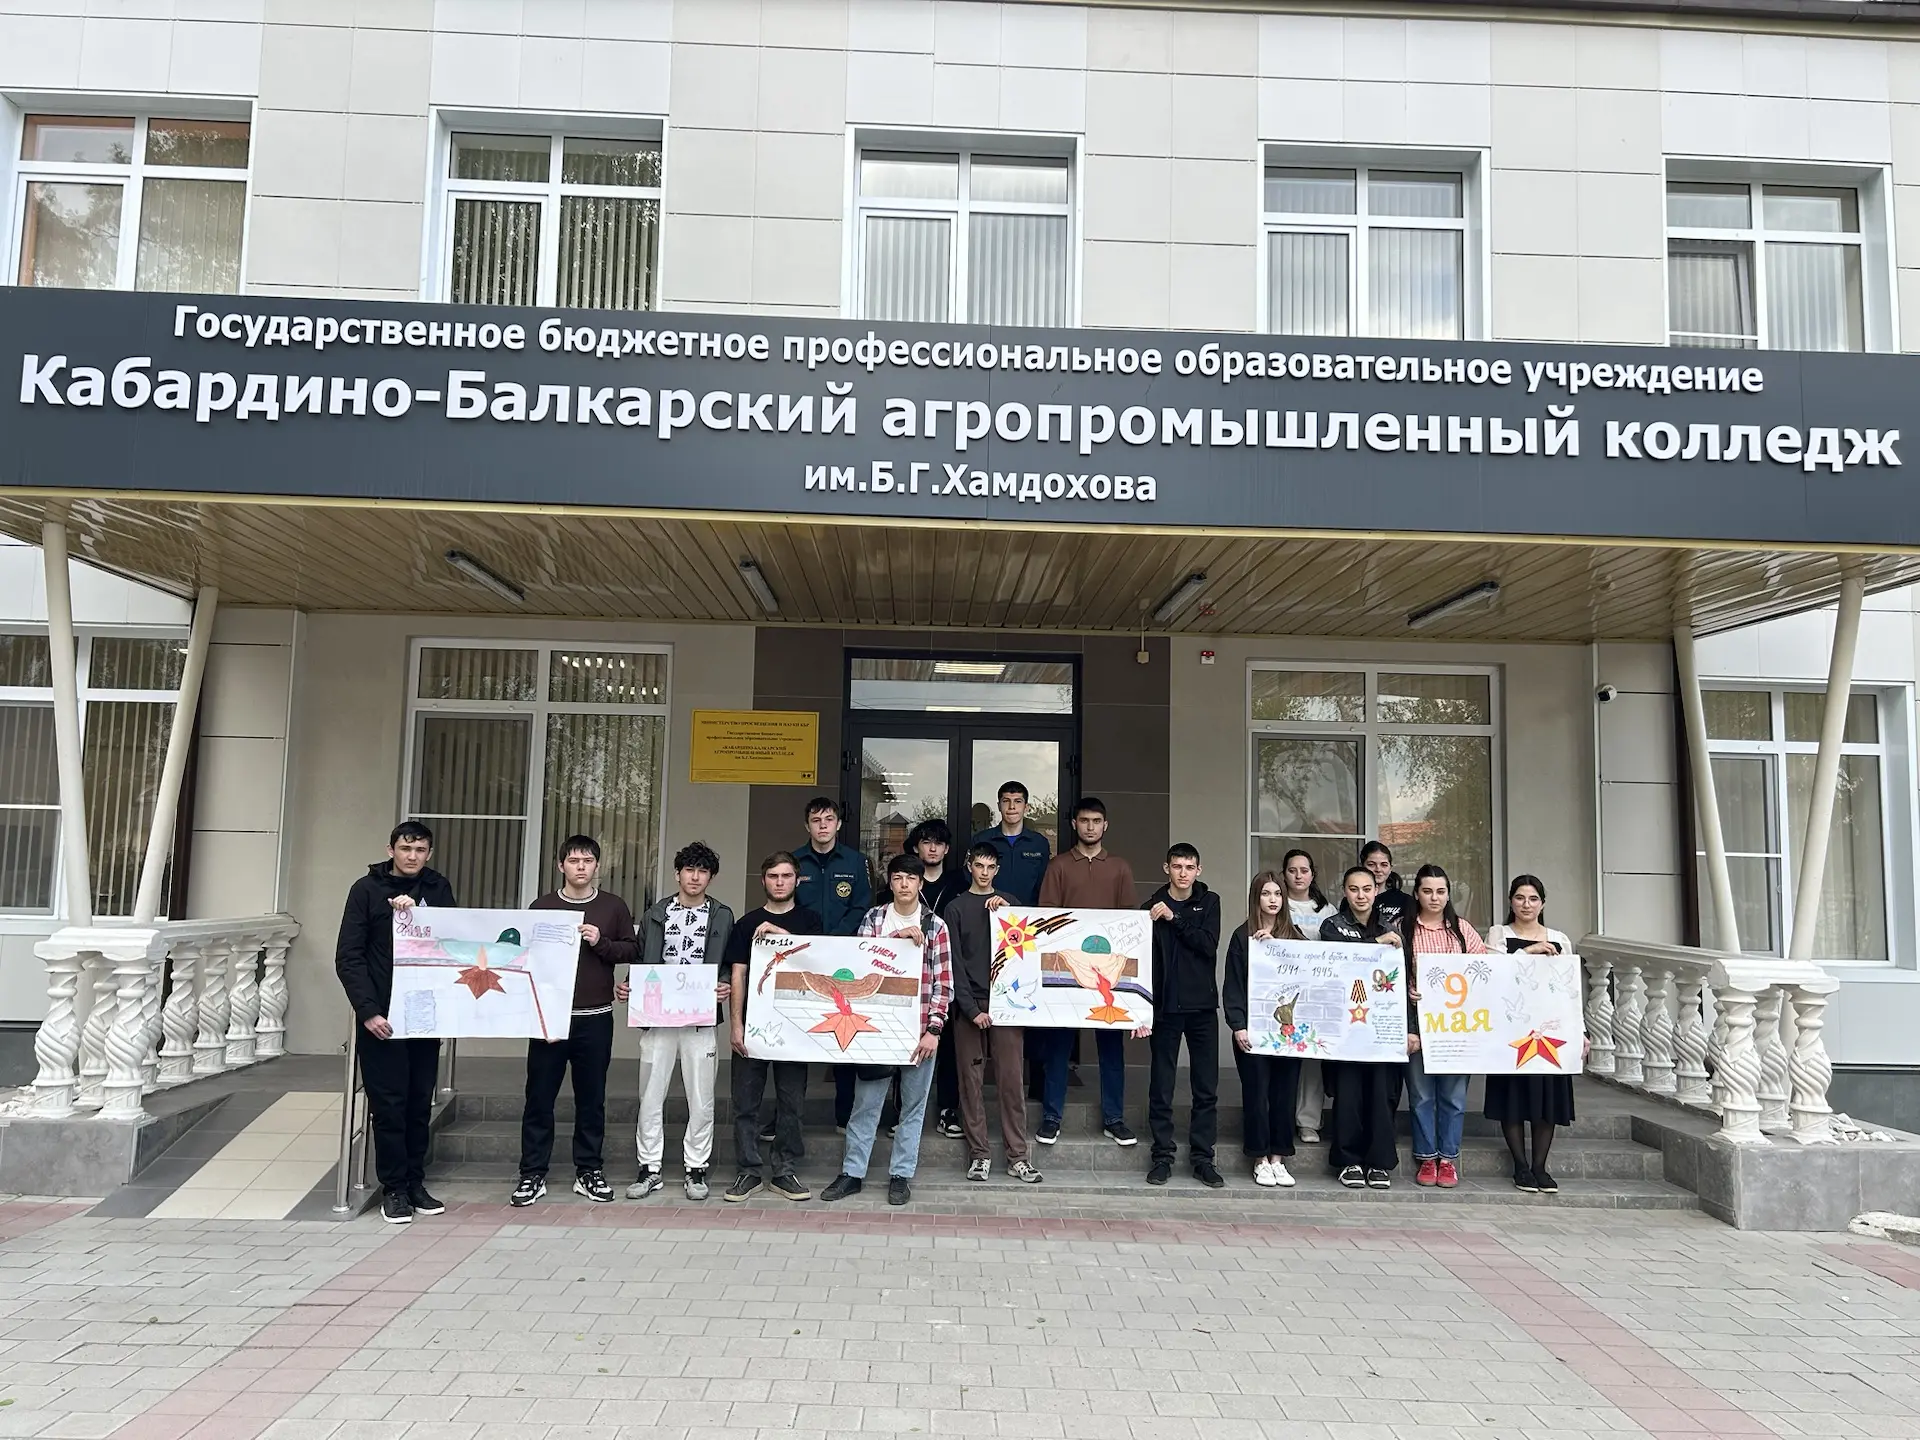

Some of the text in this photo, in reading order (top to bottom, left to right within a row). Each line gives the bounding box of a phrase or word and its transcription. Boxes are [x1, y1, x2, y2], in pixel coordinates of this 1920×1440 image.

[173, 305, 1764, 394] Государственное бюджетное профессиональное образовательное учреждение
[19, 353, 1902, 473] Кабардино-Балкарский агропромышленный колледж
[676, 971, 686, 991] 9
[1444, 971, 1469, 1009] 9
[1424, 1008, 1494, 1034] мая
